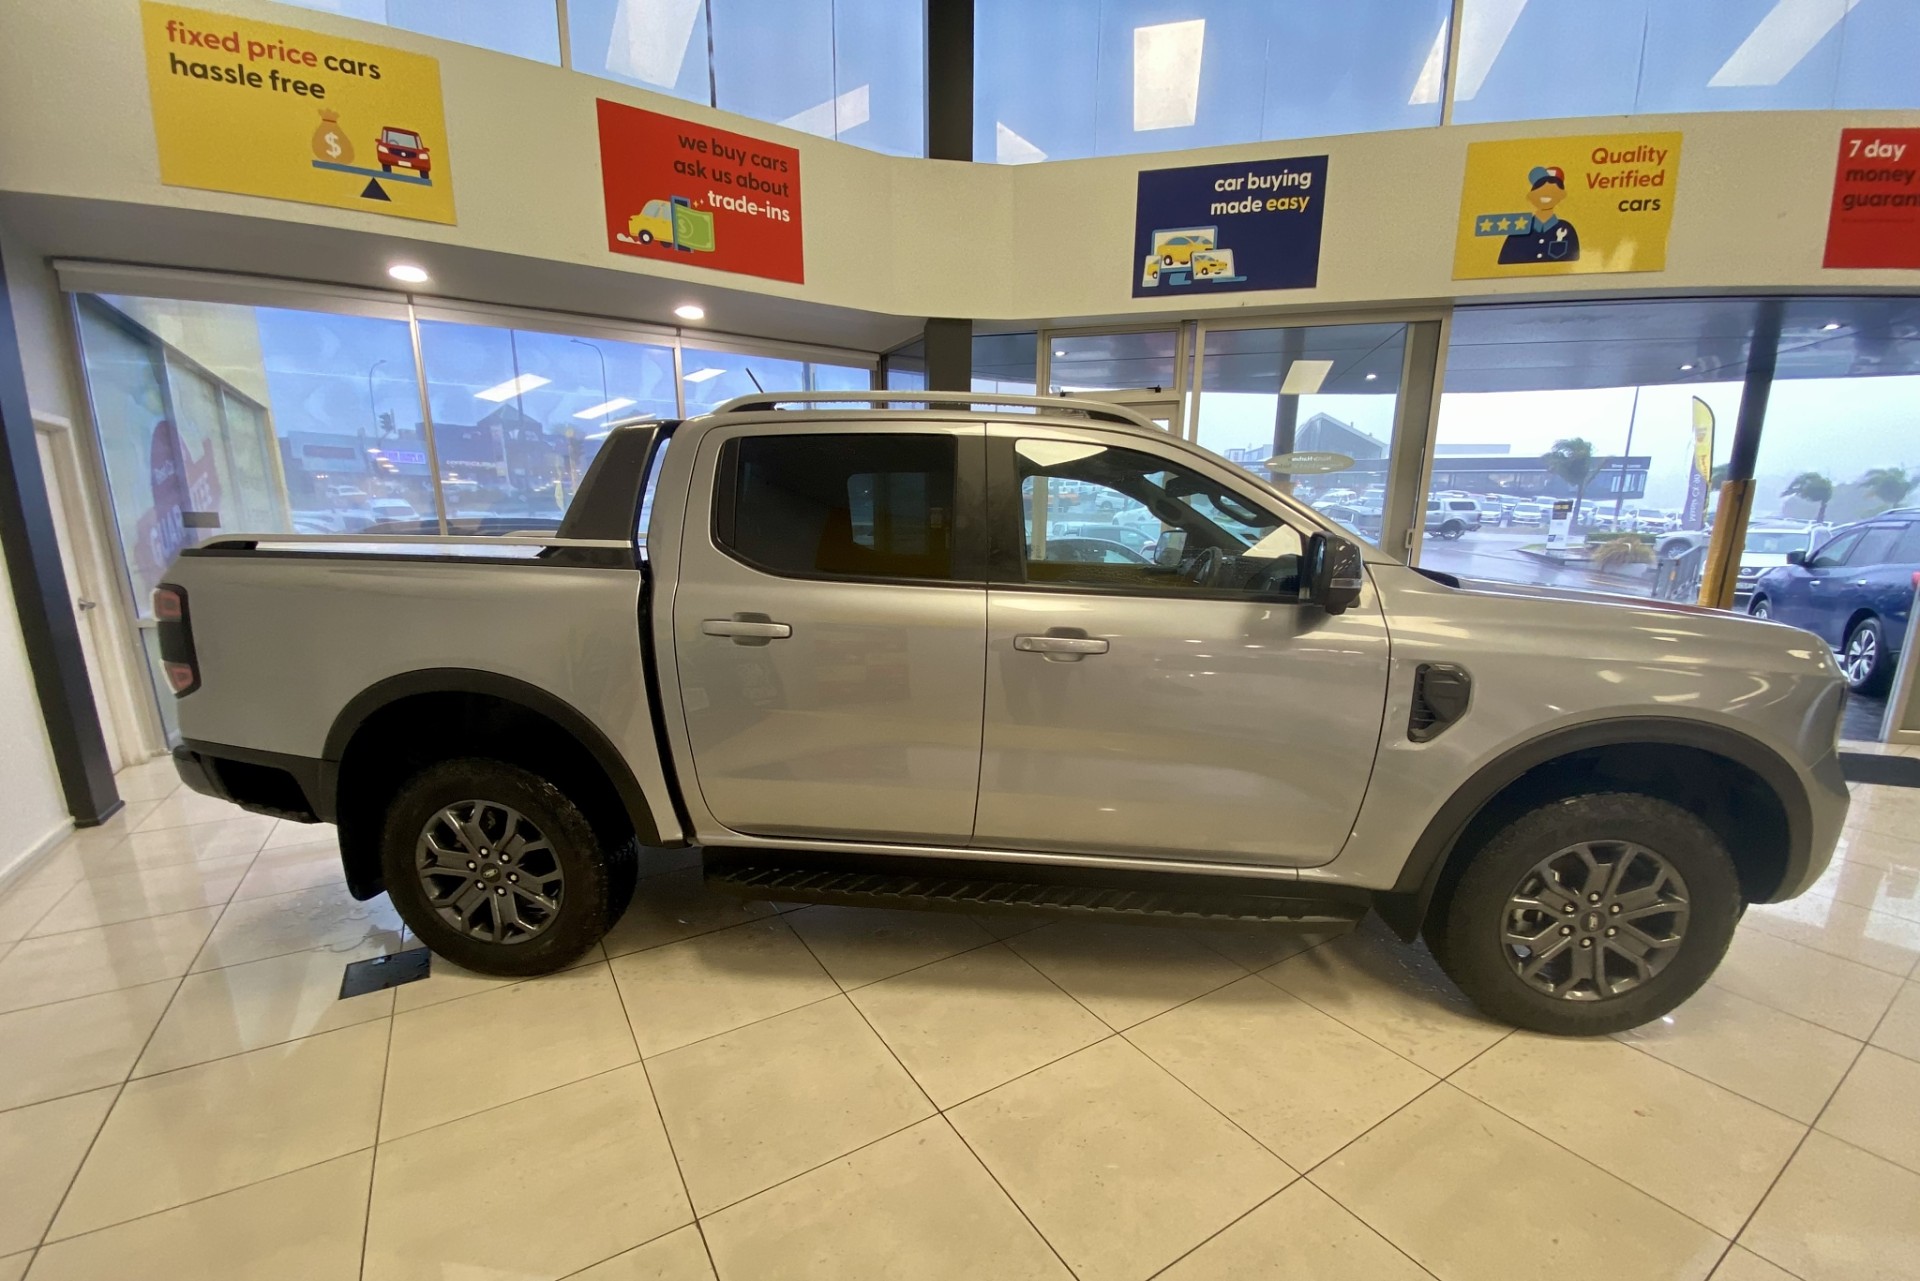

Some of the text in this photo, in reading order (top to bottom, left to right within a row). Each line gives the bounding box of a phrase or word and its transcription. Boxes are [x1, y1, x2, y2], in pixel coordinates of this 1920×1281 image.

[165, 20, 381, 80] fixed price cars
[169, 53, 325, 99] hassle free
[677, 134, 788, 173] we buy cars
[1591, 145, 1668, 166] Quality
[1849, 138, 1907, 161] 7 day
[673, 159, 789, 198] ask us about
[1214, 169, 1312, 192] car buying
[1586, 170, 1665, 189] Verified
[1845, 168, 1916, 186] money
[707, 190, 791, 222] trade-ins
[1210, 196, 1310, 216] made easy
[1618, 198, 1661, 212] cars
[1842, 193, 1920, 211] guaran
